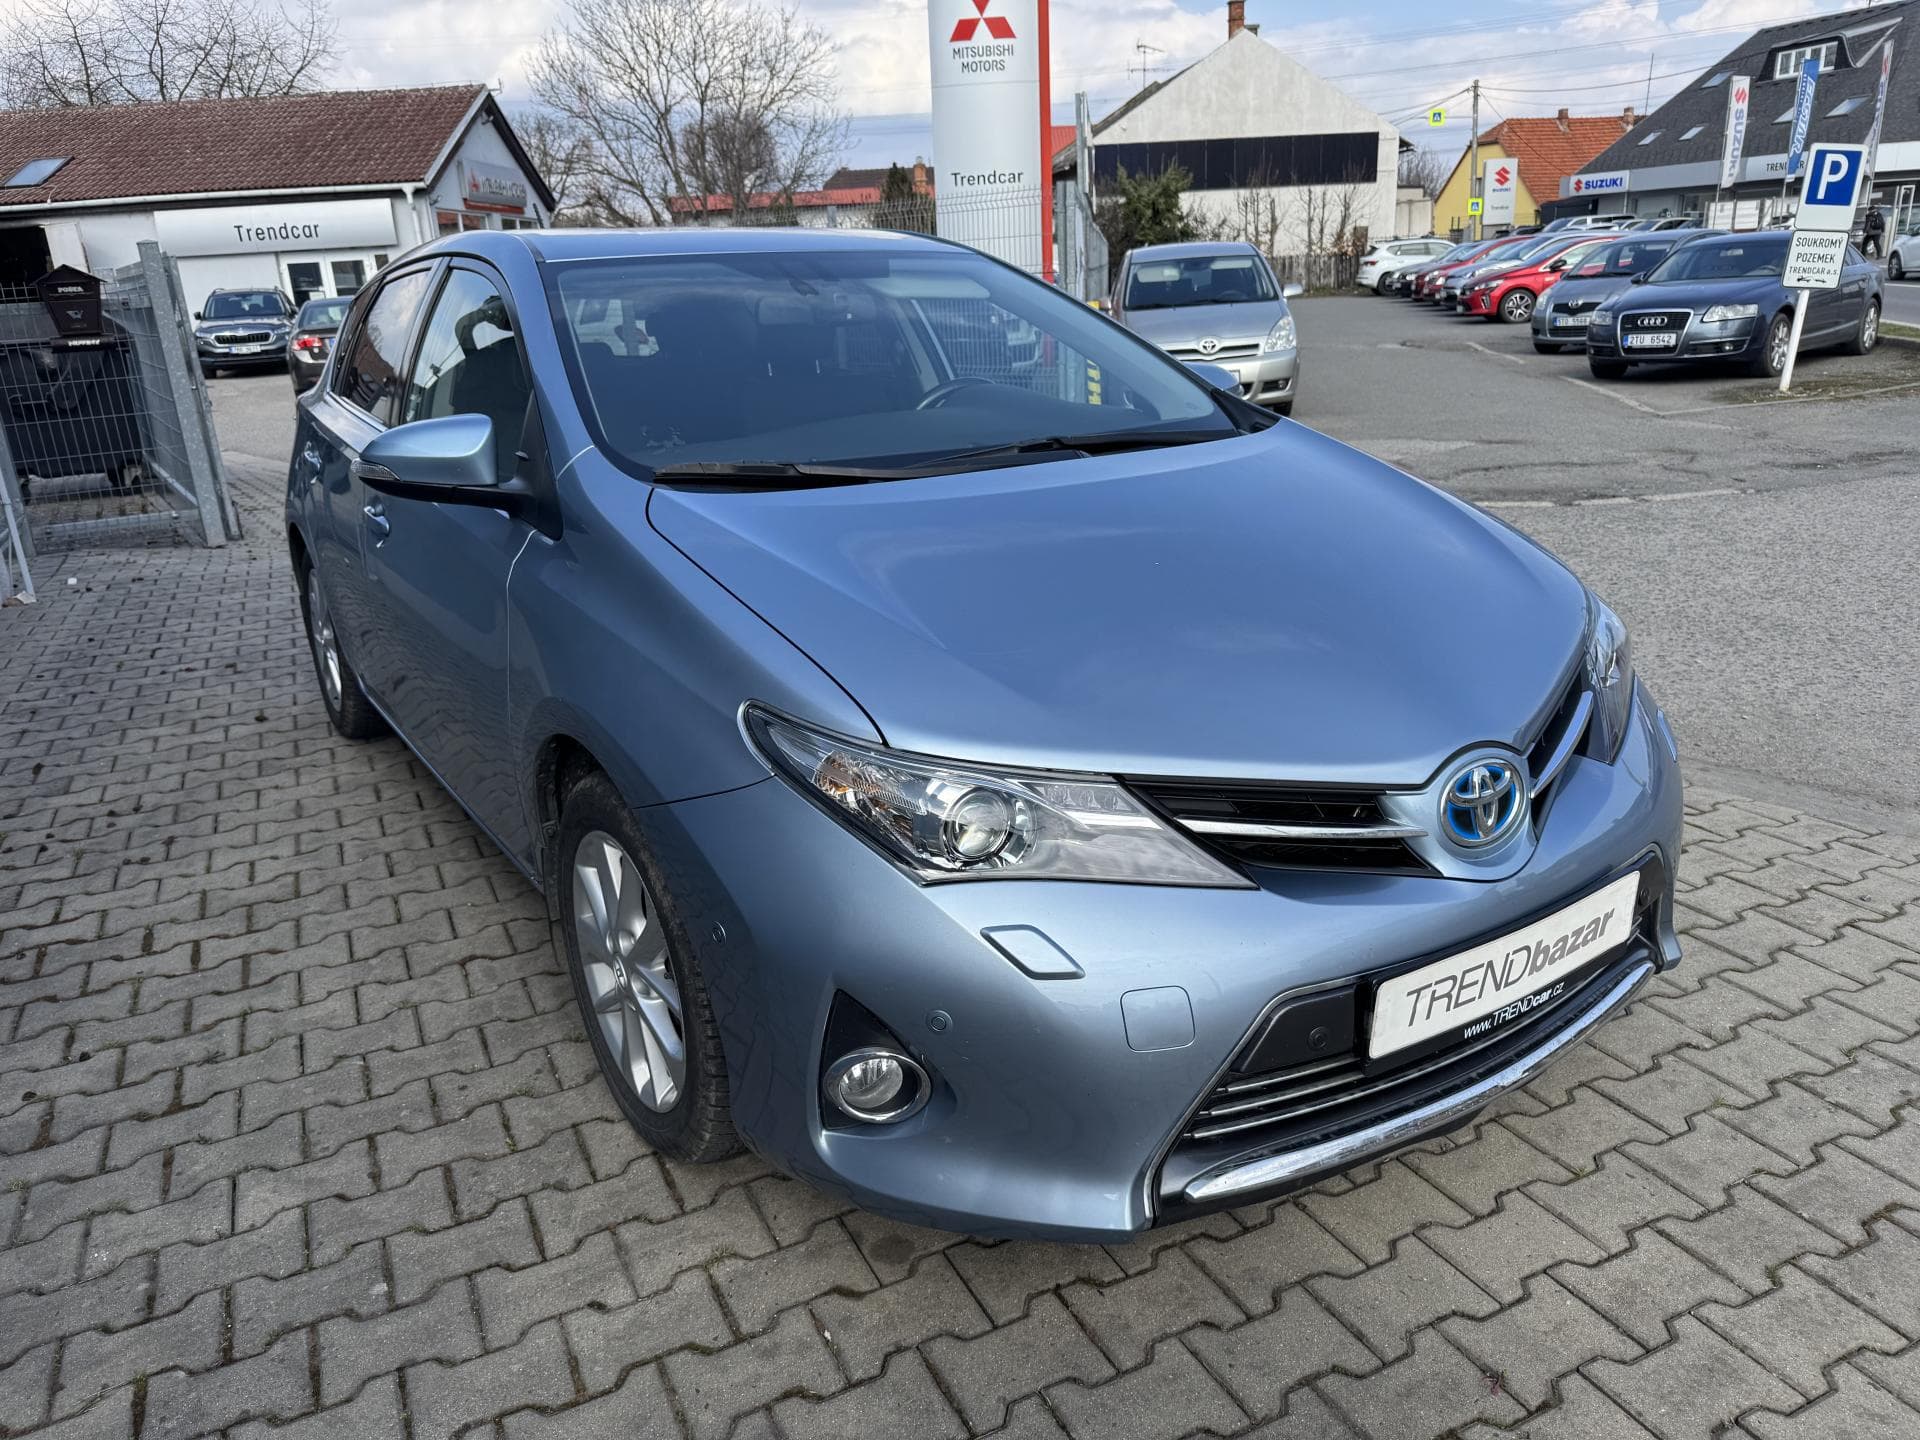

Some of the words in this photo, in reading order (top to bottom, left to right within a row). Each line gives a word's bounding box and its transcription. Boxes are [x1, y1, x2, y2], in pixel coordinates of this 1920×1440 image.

[952, 44, 1014, 59] MITSUBISHI
[961, 60, 1006, 73] MOTORS
[1727, 108, 1745, 178] SUZUKI
[951, 170, 1024, 187] Trendcar
[1584, 177, 1623, 190] SUZUKI
[1817, 153, 1849, 200] P
[233, 222, 319, 242] Trendcar
[1795, 237, 1844, 249] SOUKROMÝ
[1796, 252, 1835, 263] POZEMEK
[1789, 266, 1826, 275] TRENDCAR
[1650, 335, 1672, 344] 6542
[1406, 908, 1616, 1027] TRENDbazar
[1463, 981, 1565, 1039] www.TRENDcar.cz
